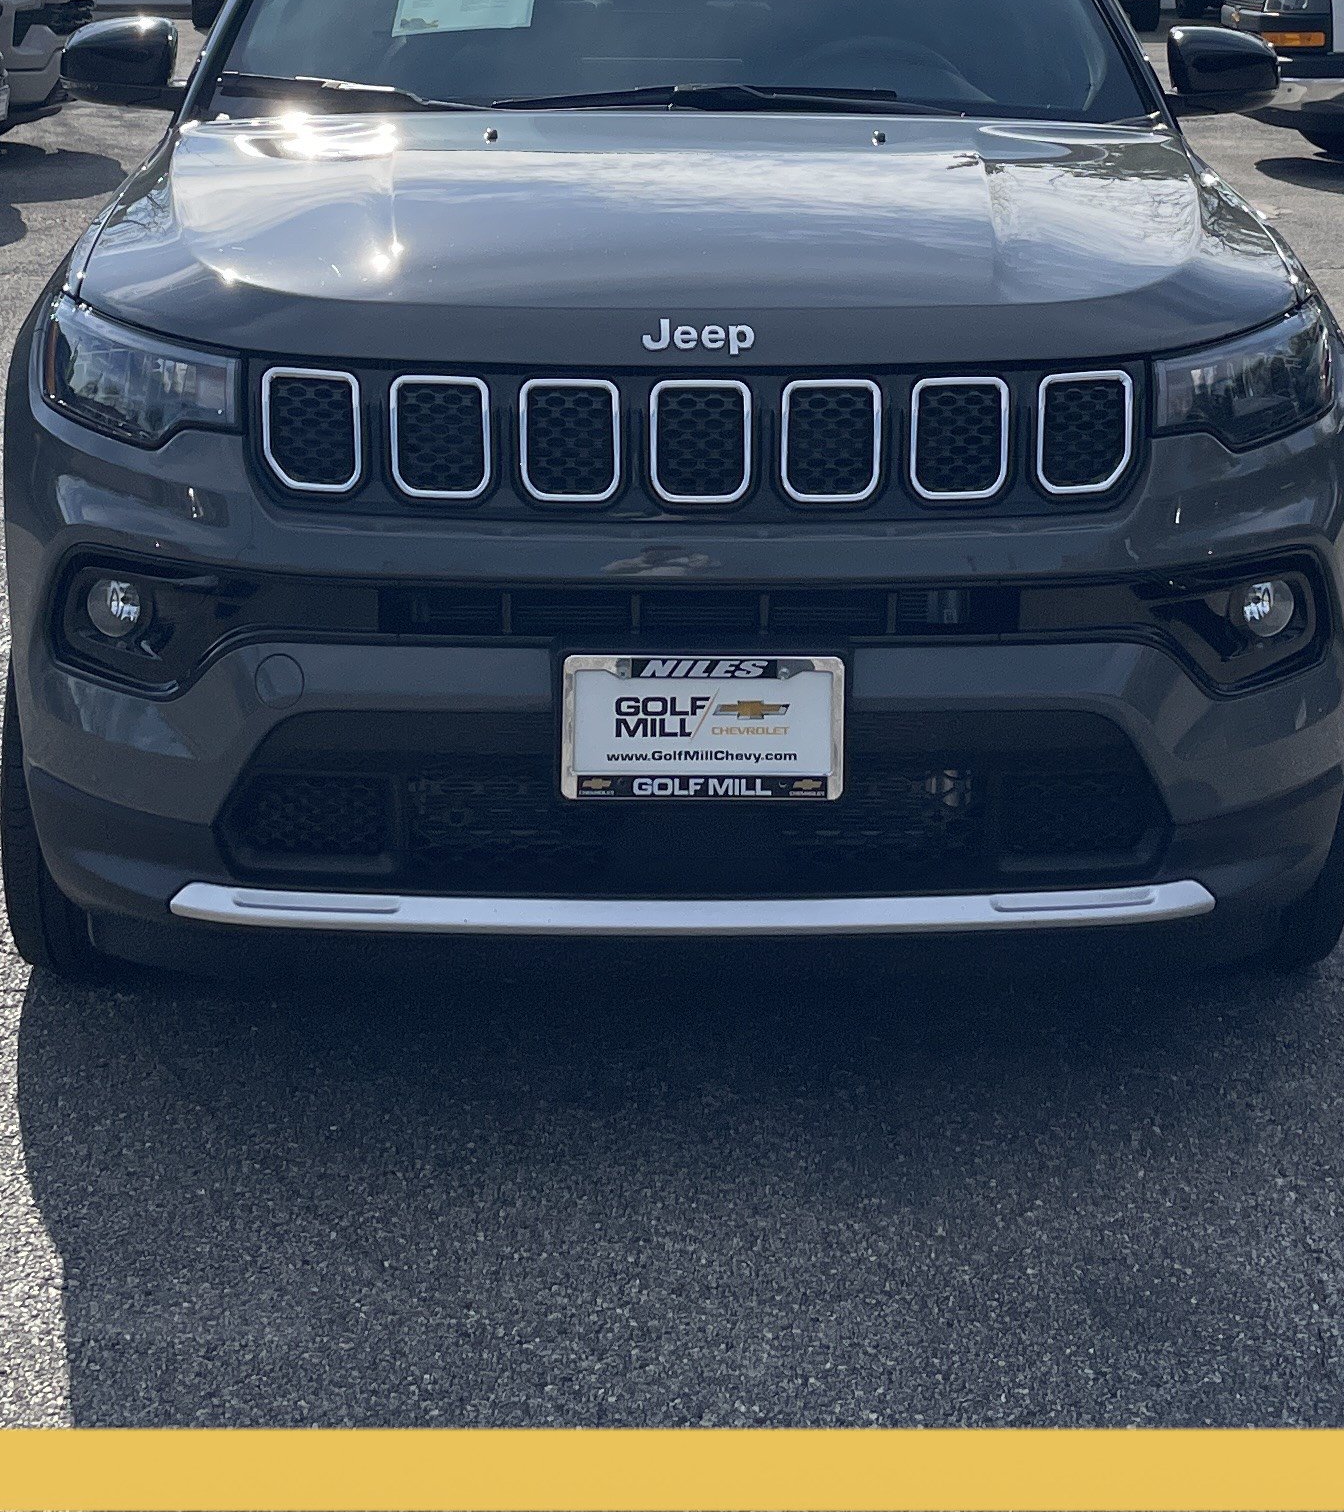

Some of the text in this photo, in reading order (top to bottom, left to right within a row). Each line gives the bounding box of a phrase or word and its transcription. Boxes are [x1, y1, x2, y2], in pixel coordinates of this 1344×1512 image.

[642, 318, 755, 355] Jeep
[639, 659, 769, 678] NILES
[614, 696, 711, 716] GOLF
[614, 718, 693, 738] MILL
[711, 726, 790, 736] CHEVROLET
[606, 750, 798, 764] www.GolfMillChevy.com
[632, 778, 772, 796] GOLF MILL
